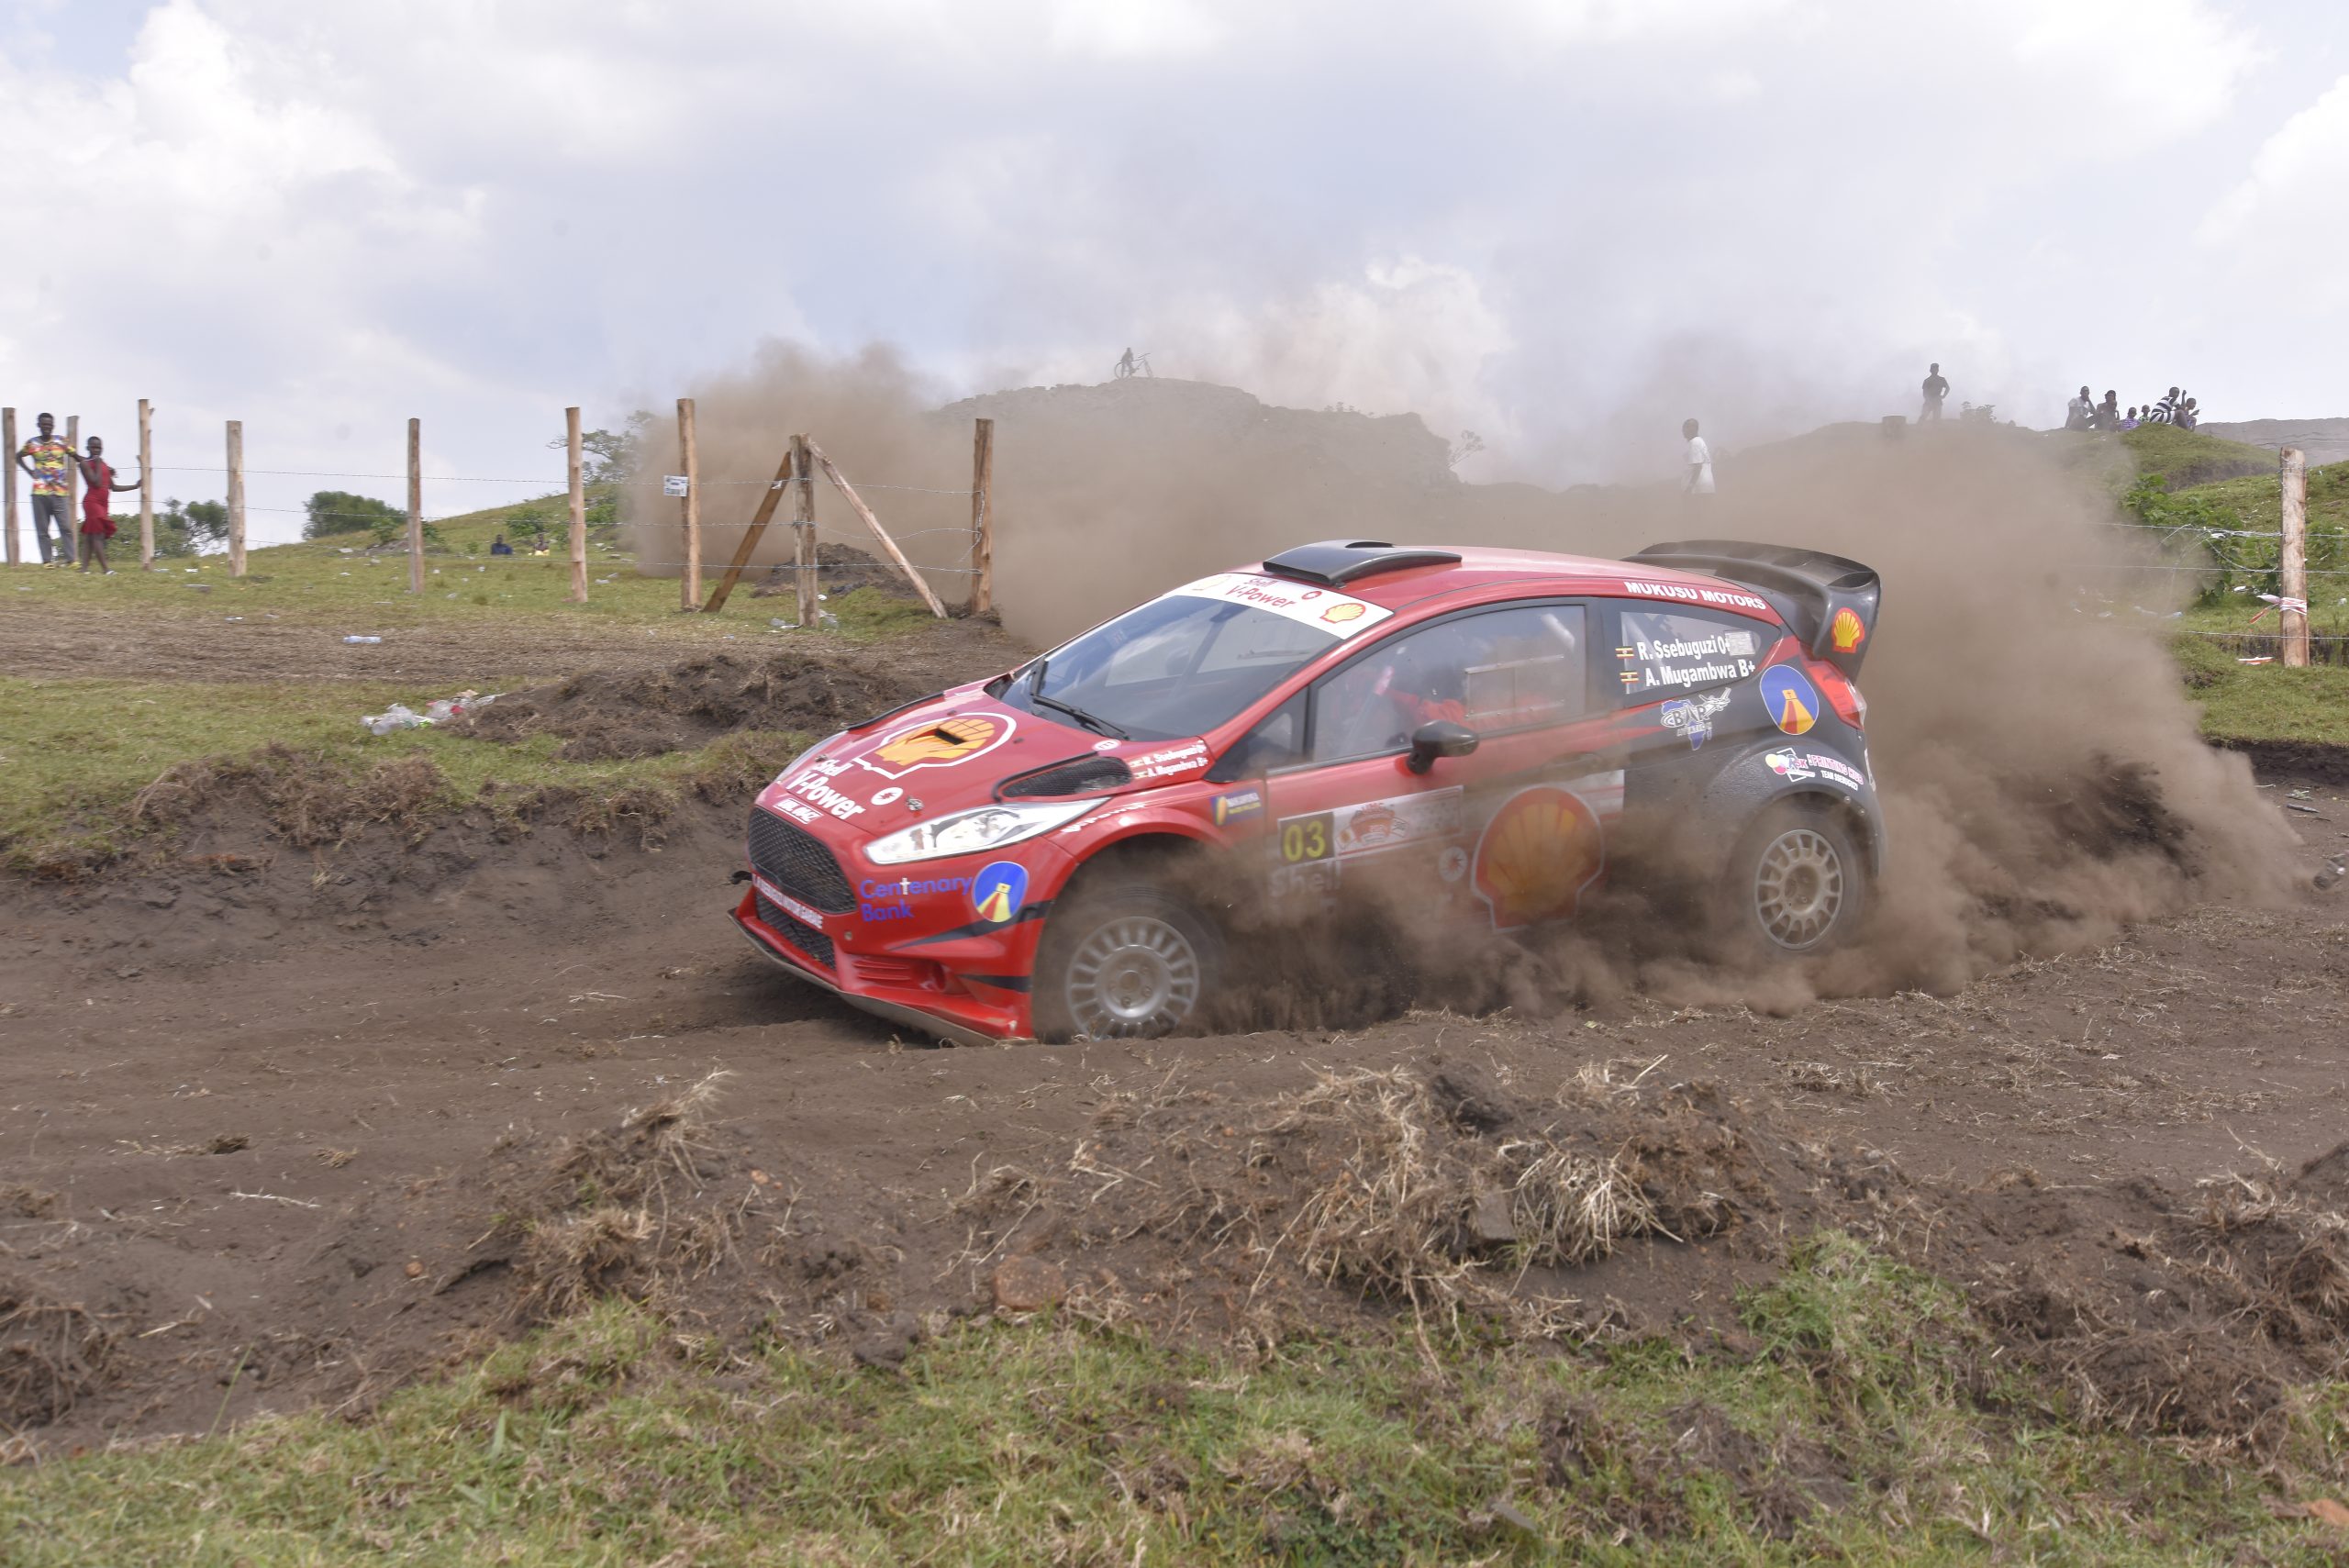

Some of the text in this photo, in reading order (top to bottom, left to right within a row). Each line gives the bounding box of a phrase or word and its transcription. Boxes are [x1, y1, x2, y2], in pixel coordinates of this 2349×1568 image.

[1225, 584, 1297, 608] V-Power
[1624, 581, 1766, 610] MUKUSU MOTORS
[1637, 641, 1653, 661] R.
[1653, 634, 1718, 660] Ssebuguzi
[1645, 659, 1755, 688] A. Mugambwa B+
[813, 759, 854, 777] Shell
[785, 771, 866, 820] V-Power
[1283, 820, 1327, 862] 03
[860, 877, 974, 899] Centenary
[861, 898, 915, 923] Bank
